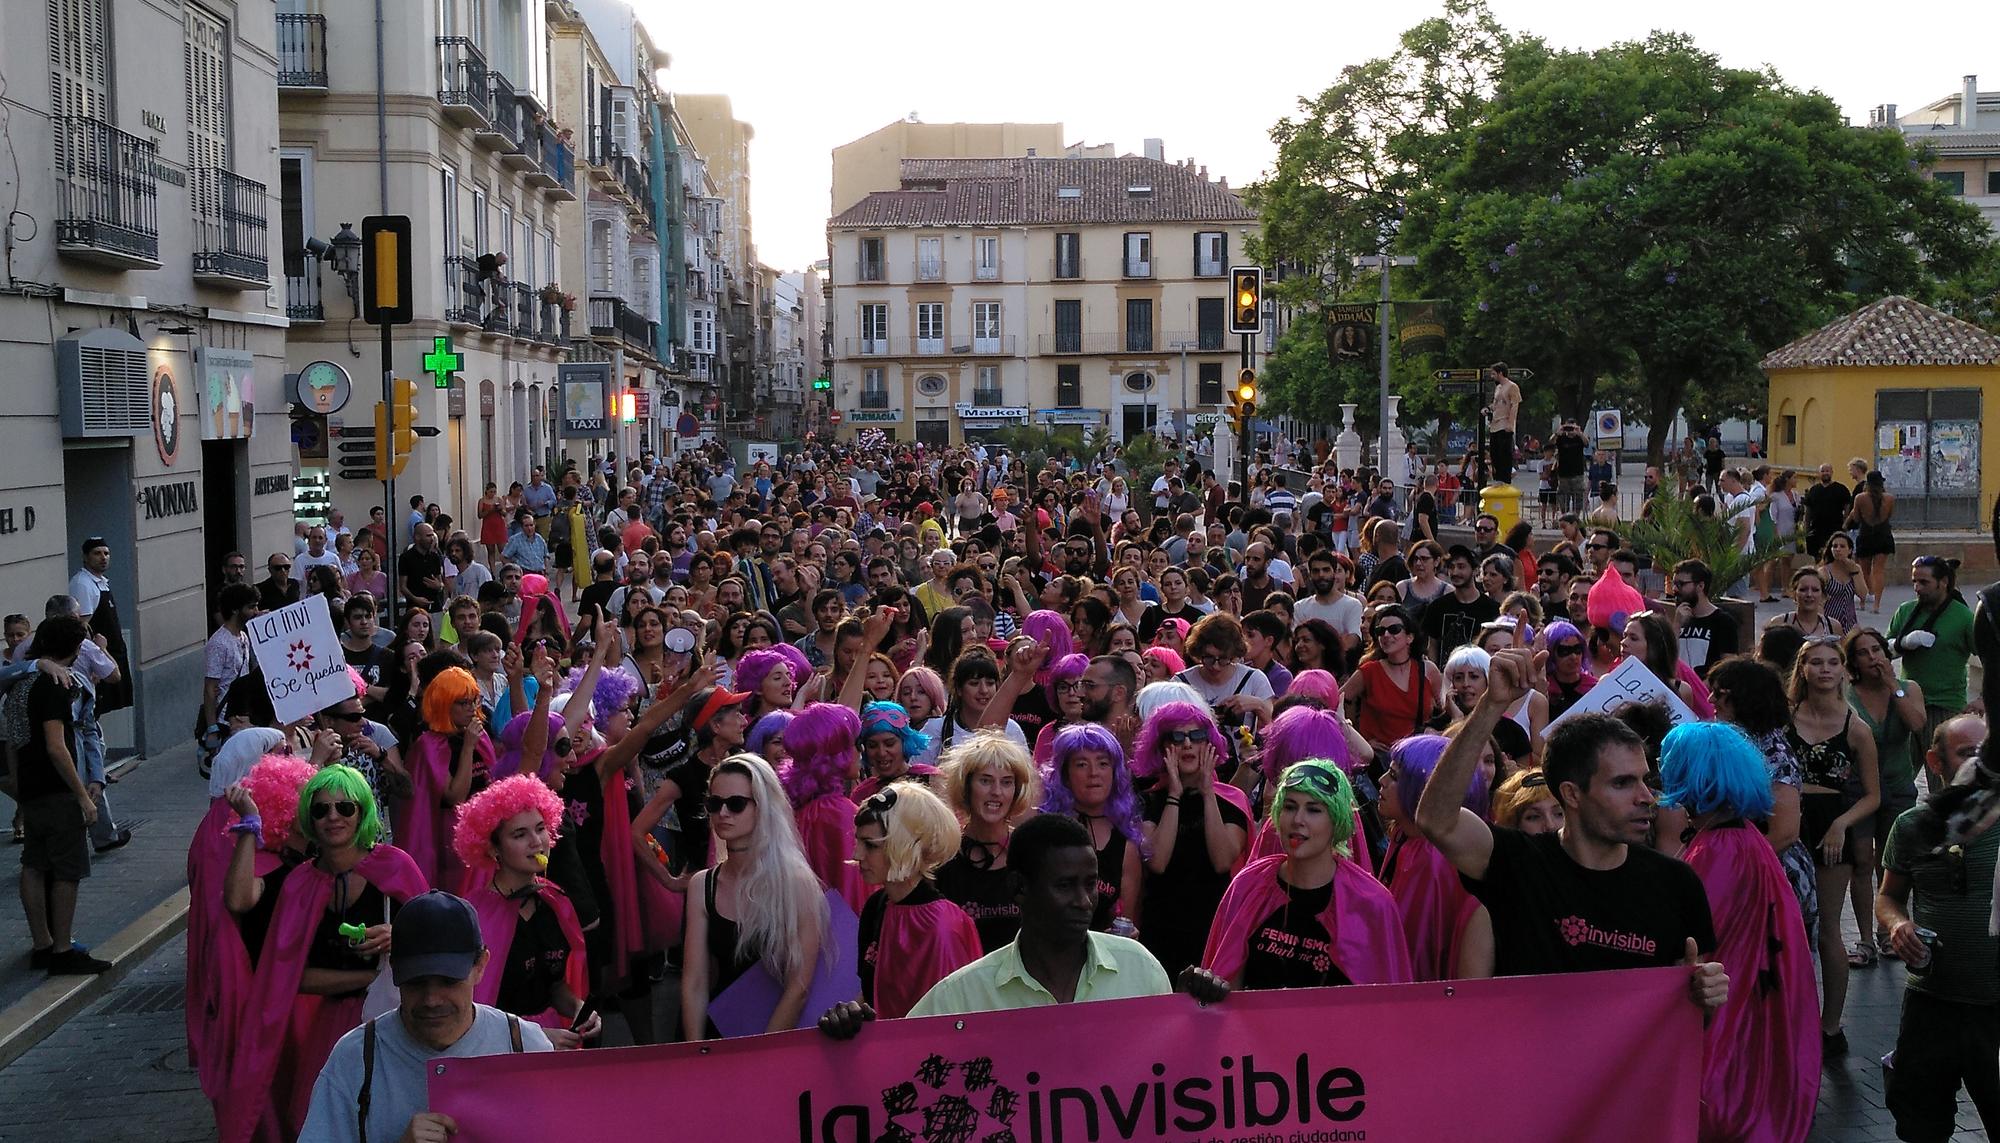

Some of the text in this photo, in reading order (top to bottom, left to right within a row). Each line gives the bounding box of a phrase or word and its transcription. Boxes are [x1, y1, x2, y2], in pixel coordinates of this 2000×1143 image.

[1328, 307, 1373, 324] ADDAMS
[570, 420, 601, 429] TAXI
[144, 481, 198, 520] NONNA
[1588, 924, 1657, 953] invisible
[799, 1052, 1367, 1143] la invisible
